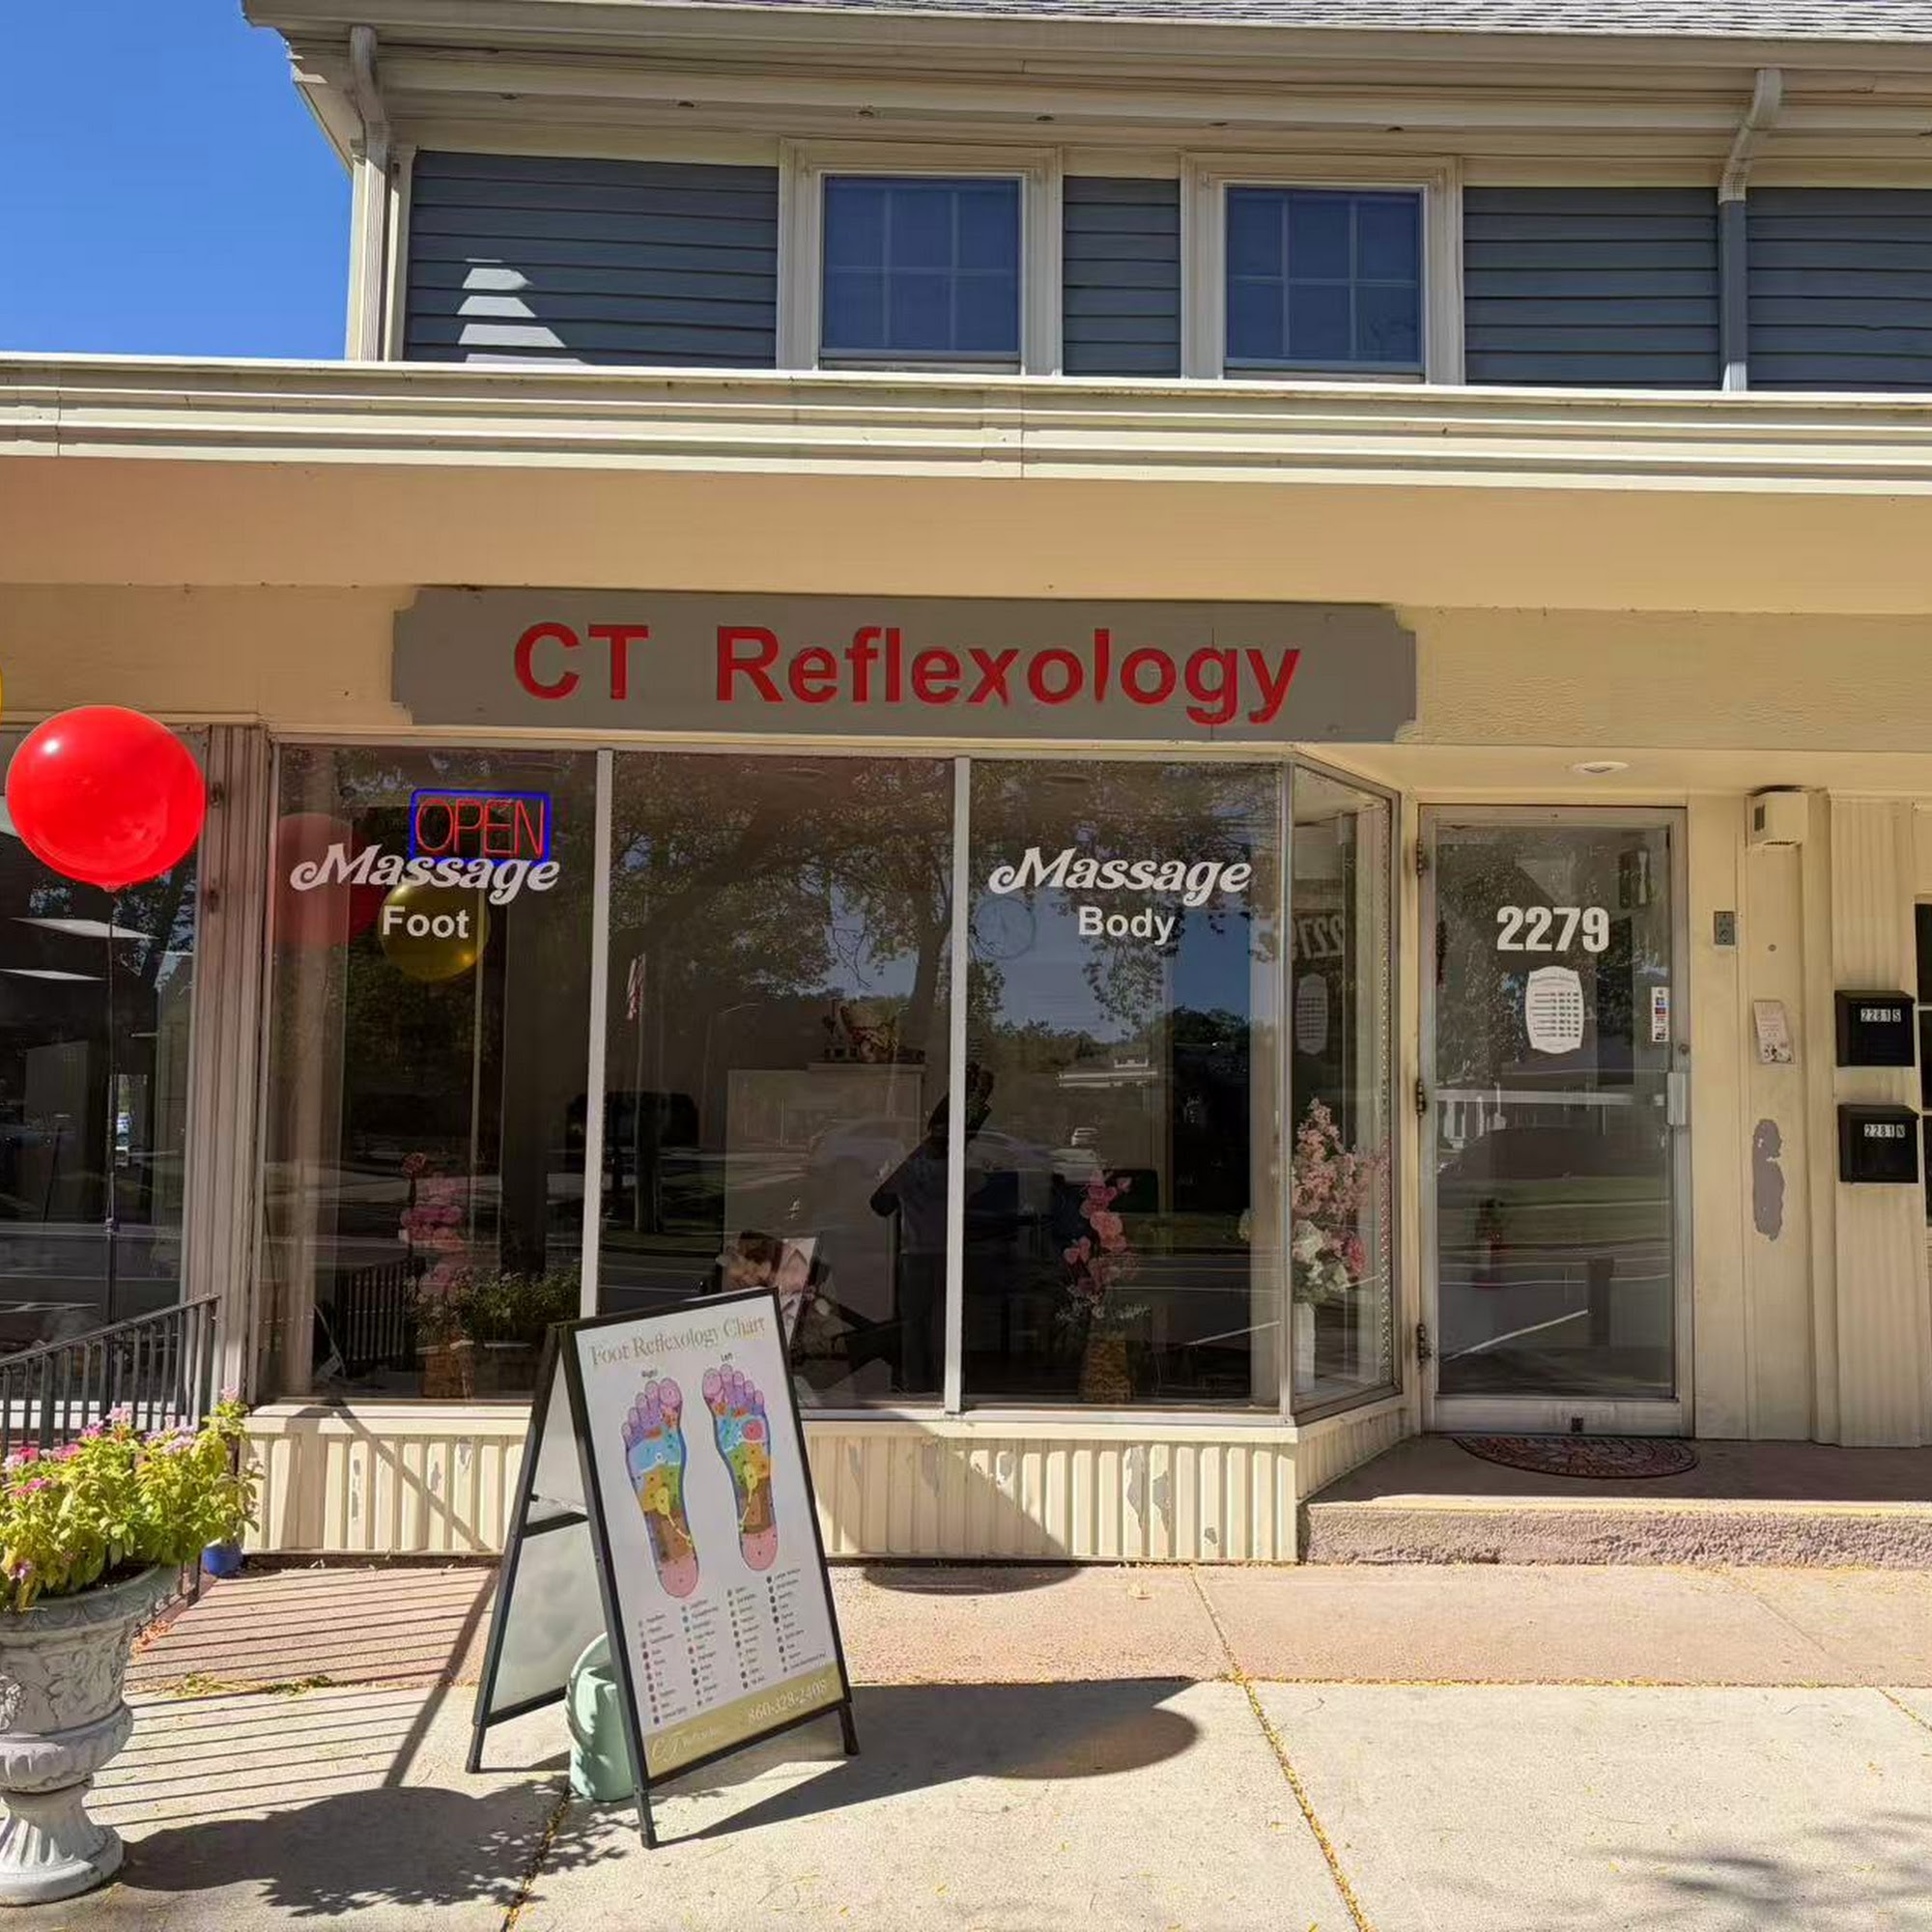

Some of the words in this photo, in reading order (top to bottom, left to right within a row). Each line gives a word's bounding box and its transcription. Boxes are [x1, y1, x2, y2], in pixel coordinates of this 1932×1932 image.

[514, 622, 651, 701] CT
[716, 626, 1302, 727] Reflexology
[415, 799, 545, 859] OPEN
[291, 842, 560, 905] Massage
[988, 845, 1253, 907] Massage
[382, 905, 469, 939] Foot
[1078, 906, 1176, 946] Body
[1496, 905, 1610, 953] 2279
[589, 1344, 630, 1366] Foot
[633, 1328, 719, 1358] Reflexology
[723, 1317, 765, 1339] Chart
